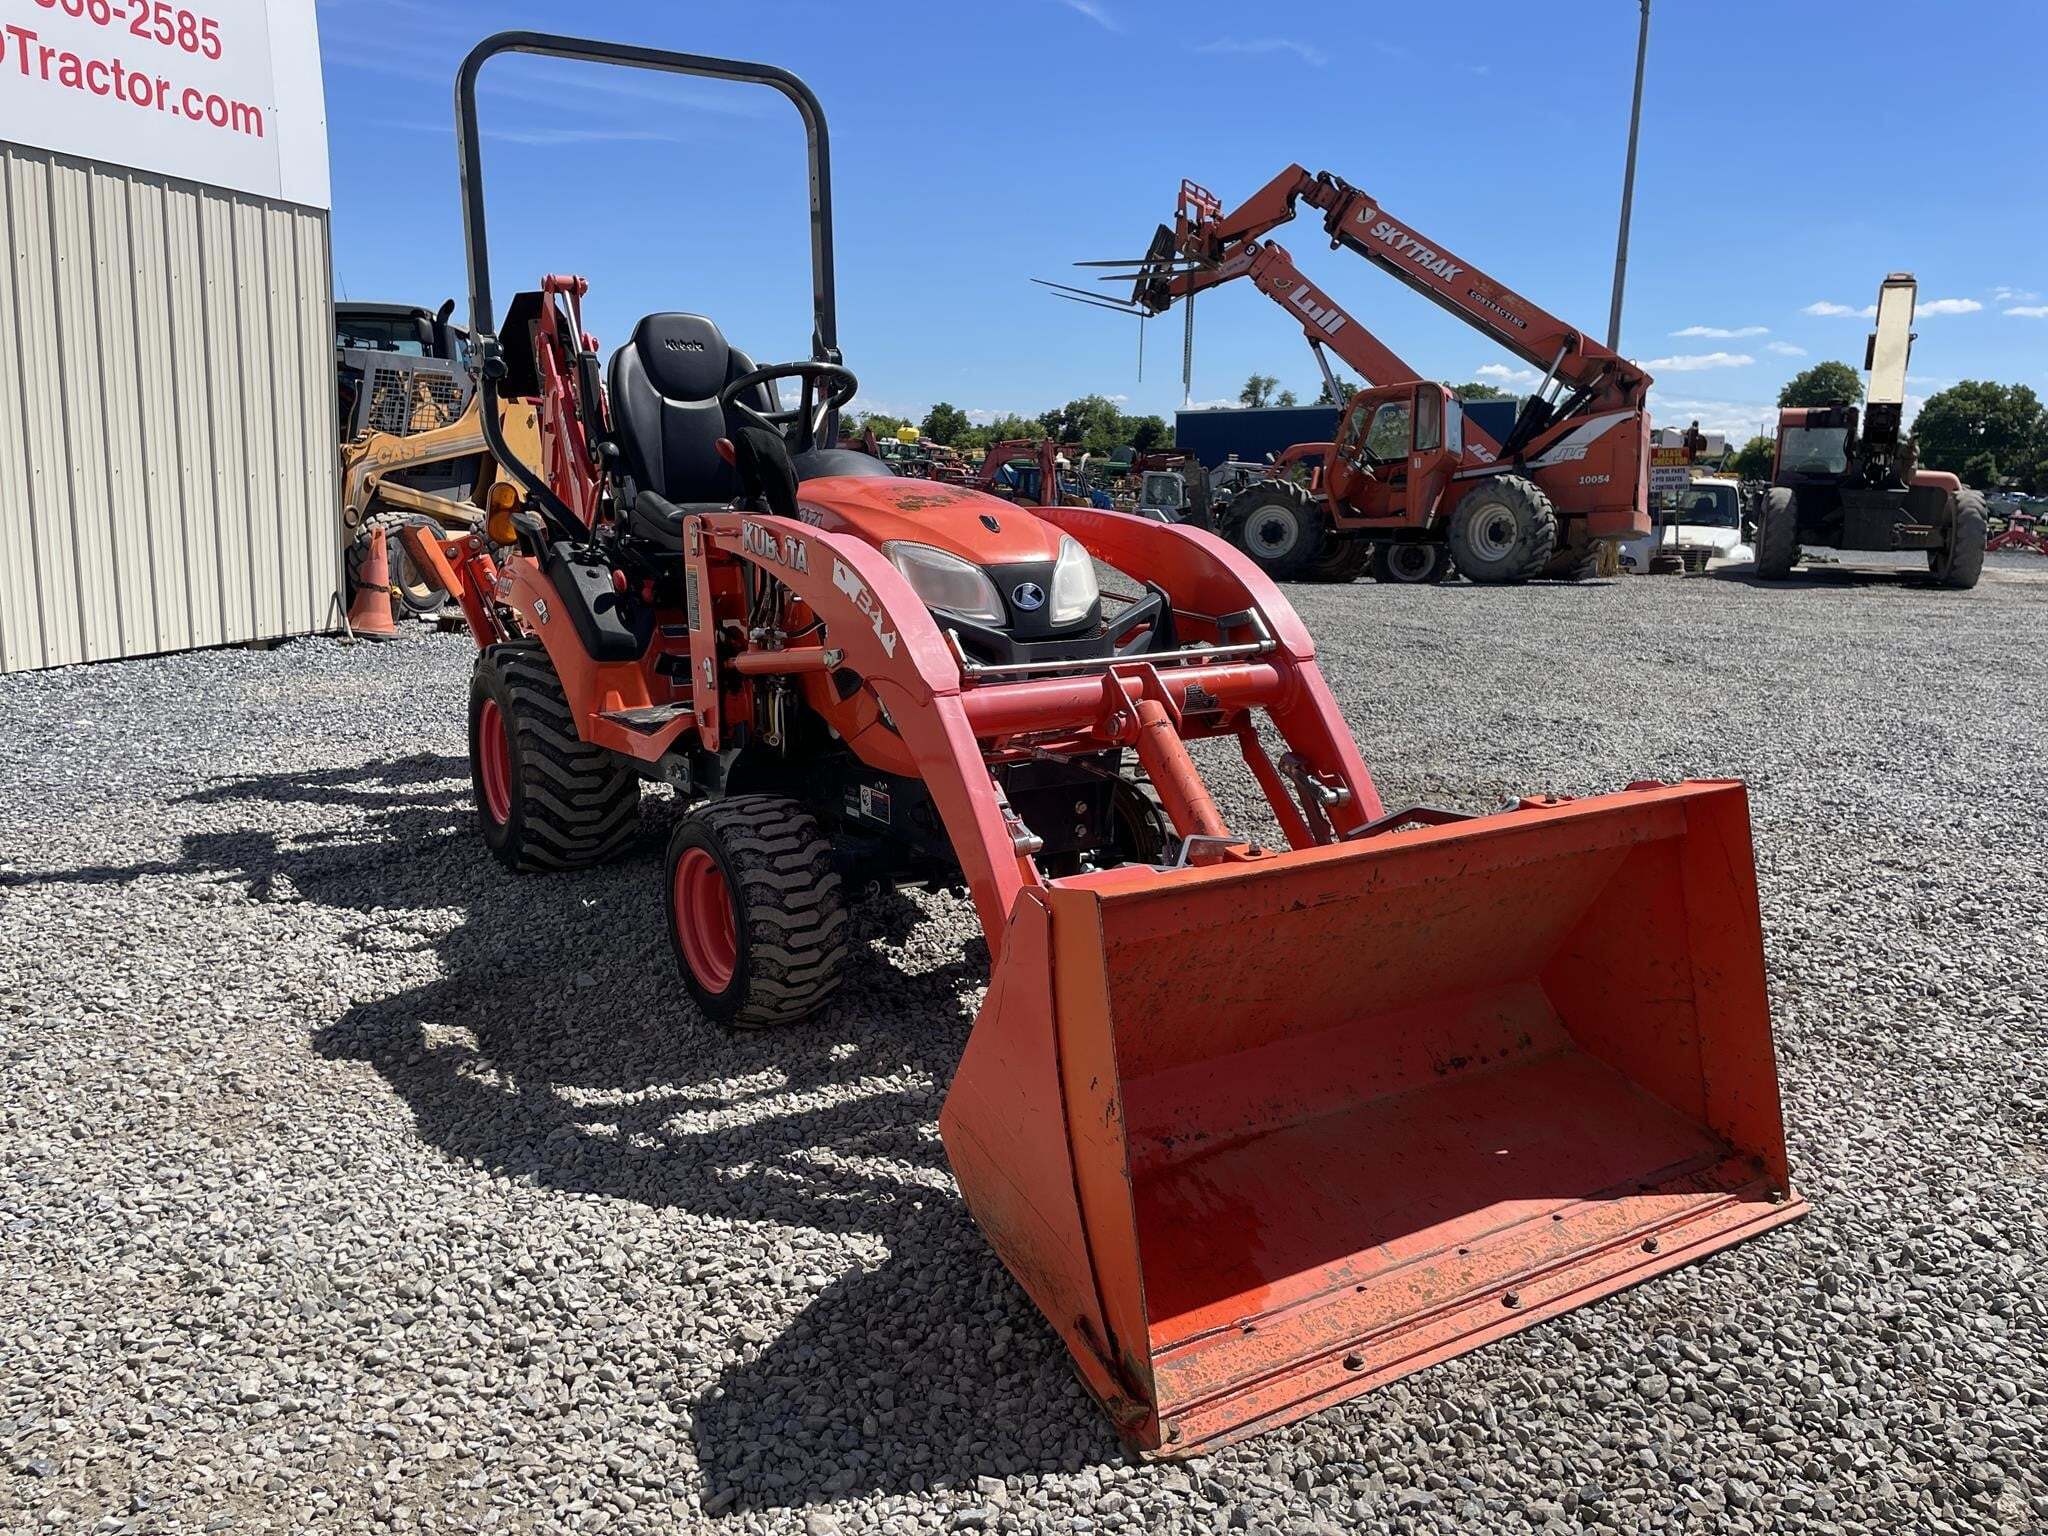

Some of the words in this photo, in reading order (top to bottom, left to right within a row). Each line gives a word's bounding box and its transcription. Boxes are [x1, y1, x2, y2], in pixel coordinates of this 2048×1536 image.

[34, 0, 222, 60] 6-2585
[0, 23, 264, 138] Tractor.com
[1246, 245, 1257, 256] 9
[1370, 221, 1464, 283] SKYTRAK
[1288, 283, 1346, 335] Lull
[1469, 290, 1526, 328] CONTRACTING
[1578, 474, 1610, 485] 10054
[742, 519, 810, 576] KUBOTA
